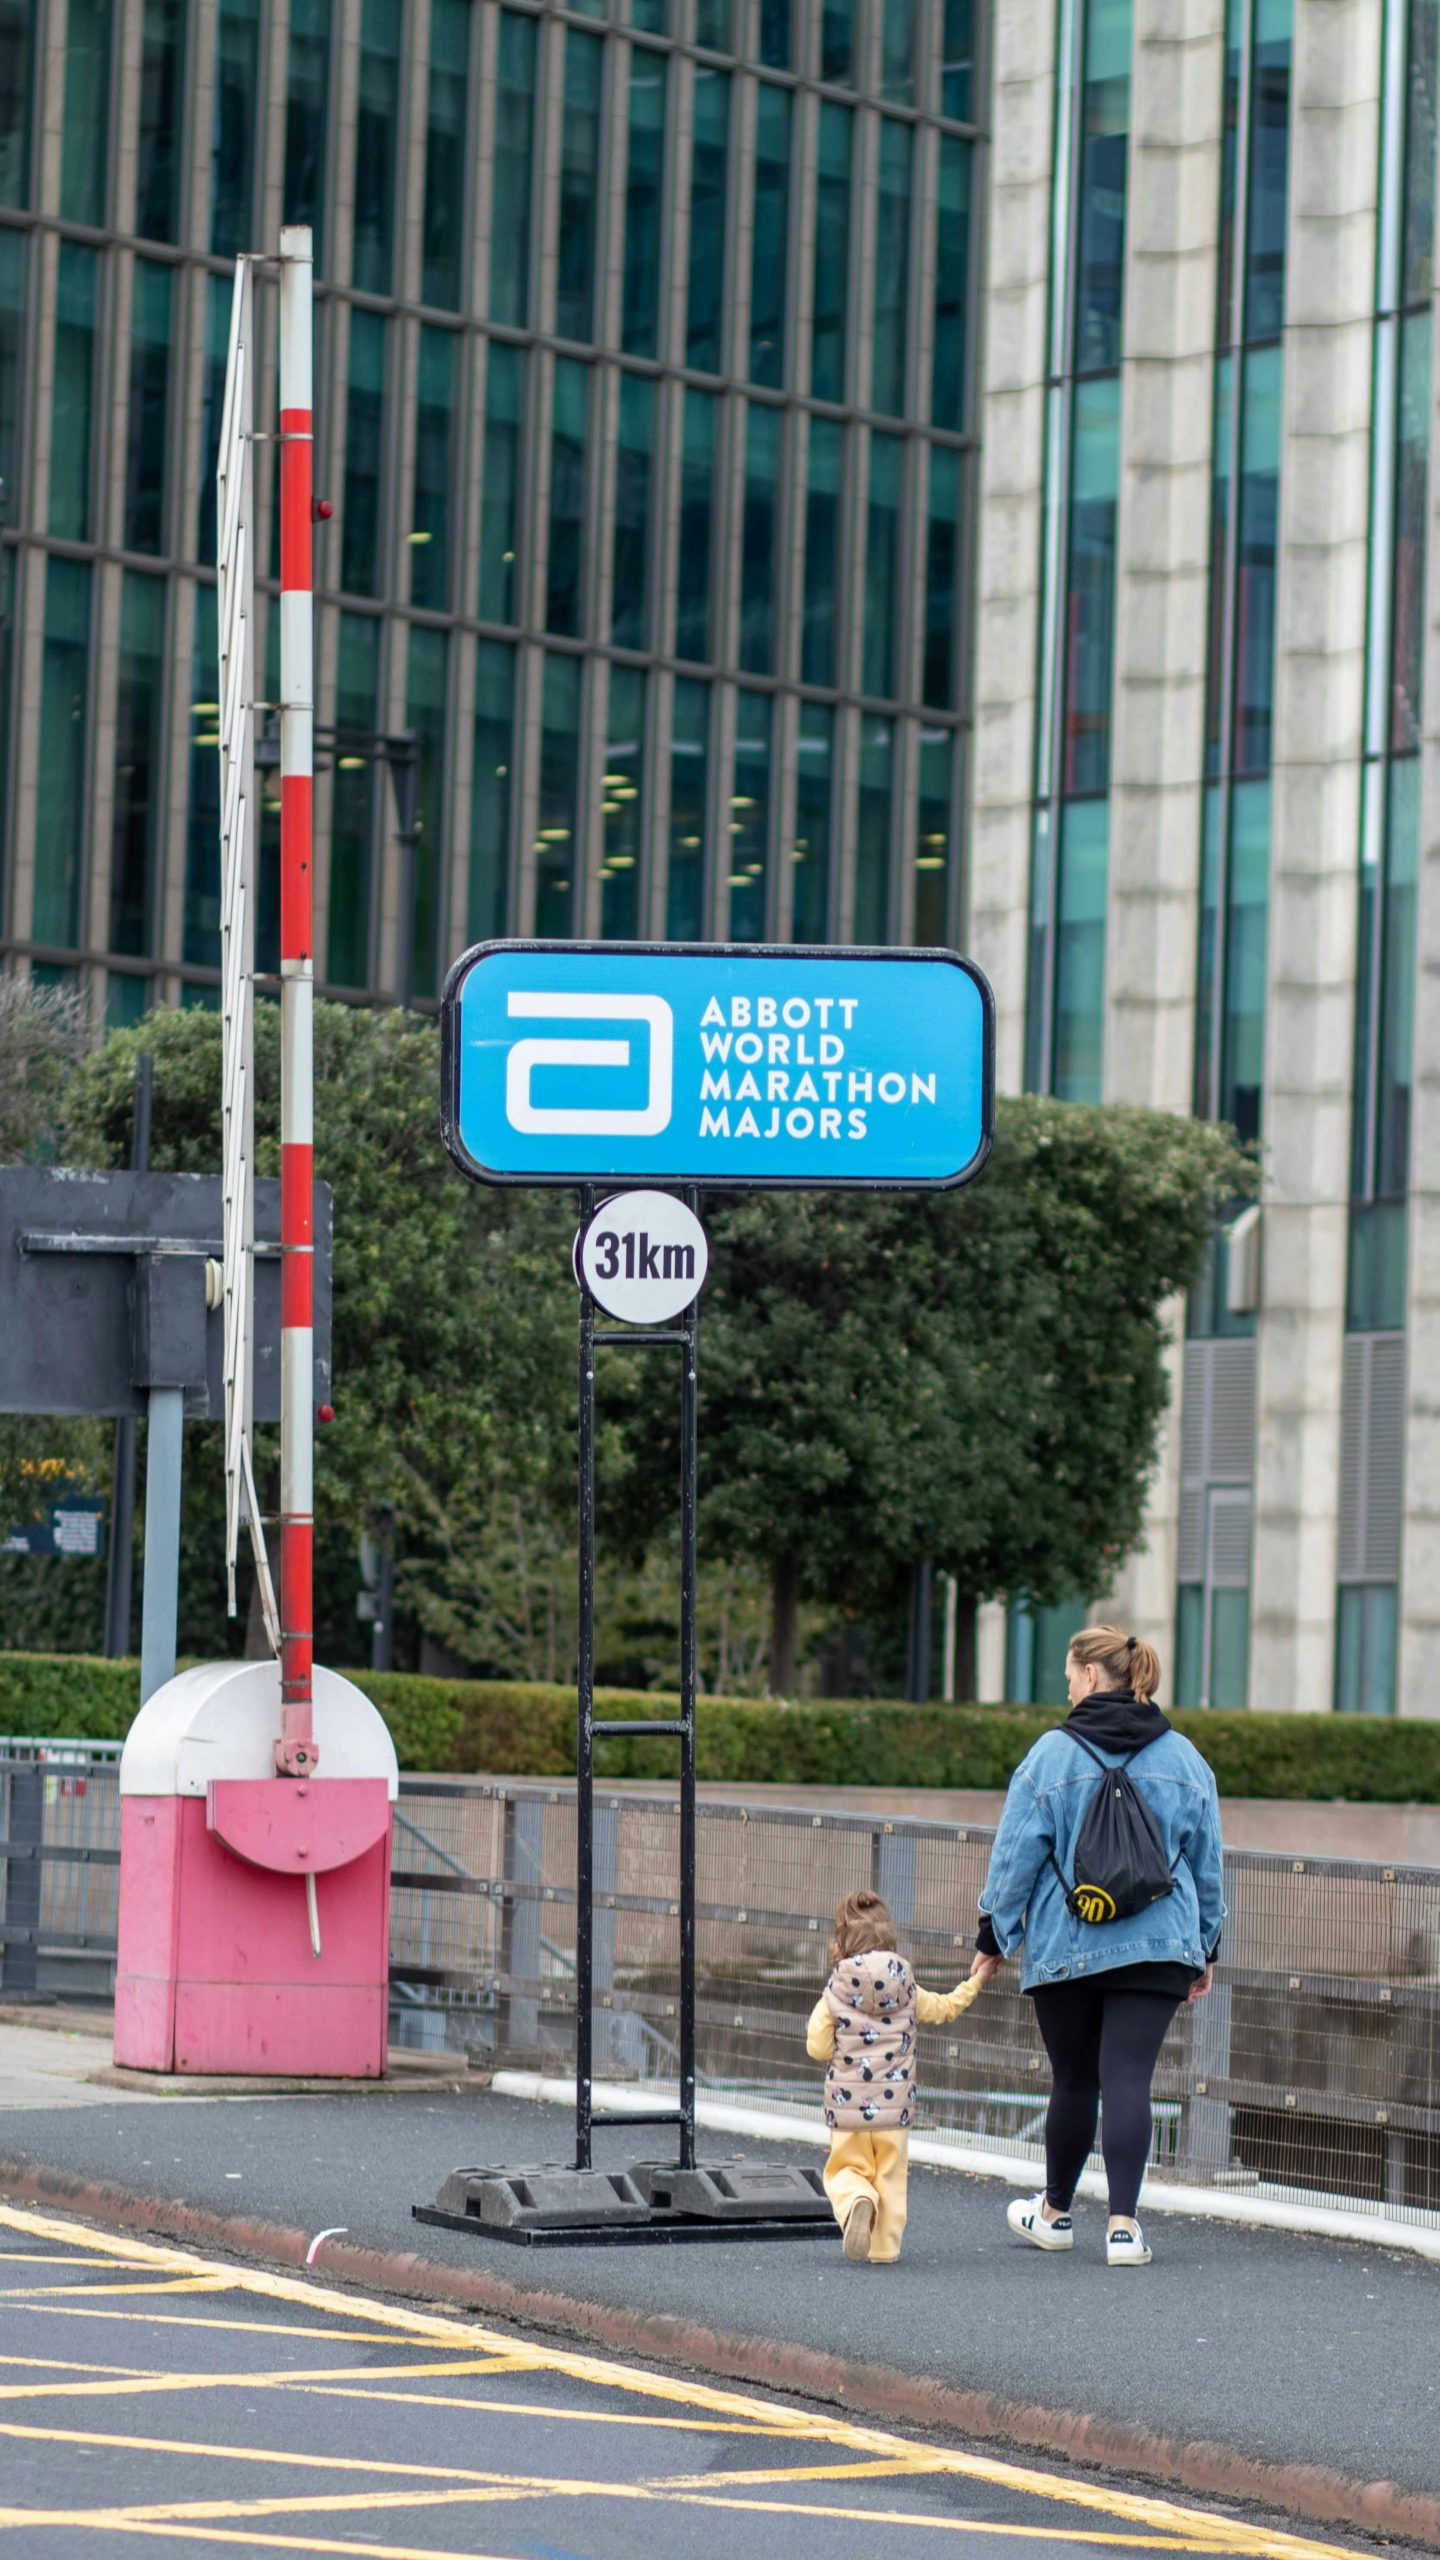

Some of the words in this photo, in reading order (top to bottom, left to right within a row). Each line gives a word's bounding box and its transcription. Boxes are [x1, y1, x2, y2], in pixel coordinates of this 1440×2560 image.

[699, 995, 860, 1031] ABBOTT
[699, 1031, 846, 1066] WORLD
[698, 1069, 937, 1104] MARATHON
[698, 1106, 868, 1141] MAJORS
[594, 1230, 696, 1281] 31km
[1077, 1894, 1105, 1923] 90
